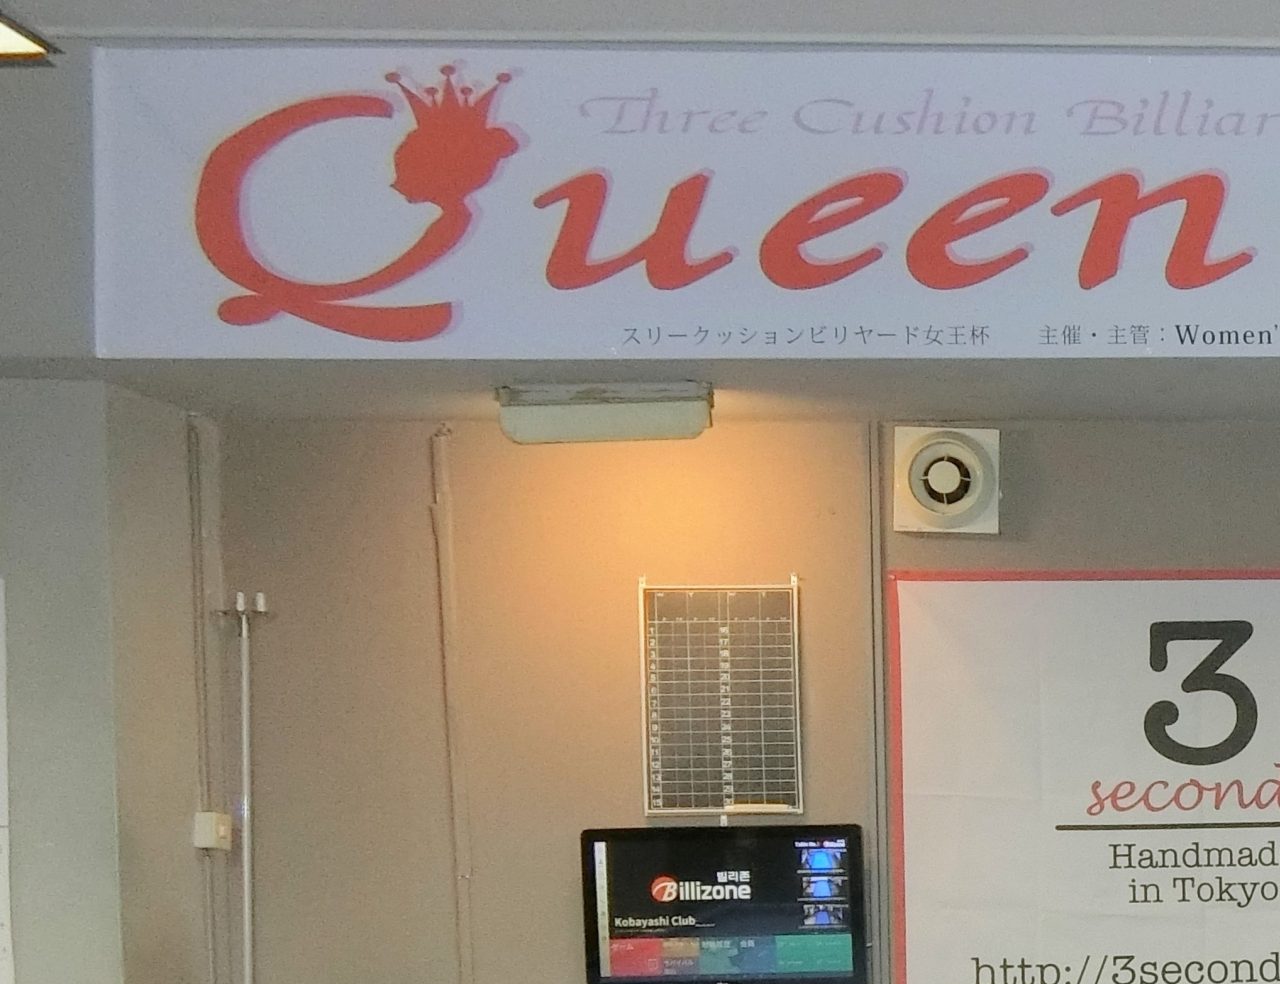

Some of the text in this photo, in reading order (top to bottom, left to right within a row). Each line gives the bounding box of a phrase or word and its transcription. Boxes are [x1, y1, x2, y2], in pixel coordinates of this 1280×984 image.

[578, 88, 768, 137] Three
[793, 88, 1039, 137] Cushion
[195, 62, 1253, 342] Queen
[621, 325, 990, 346] スリークッションビリヤード女王杯
[1144, 620, 1258, 765] 3
[655, 879, 752, 902] Billizone
[1128, 875, 1279, 908] in Tokyo
[614, 914, 696, 929] Kobayashi Club
